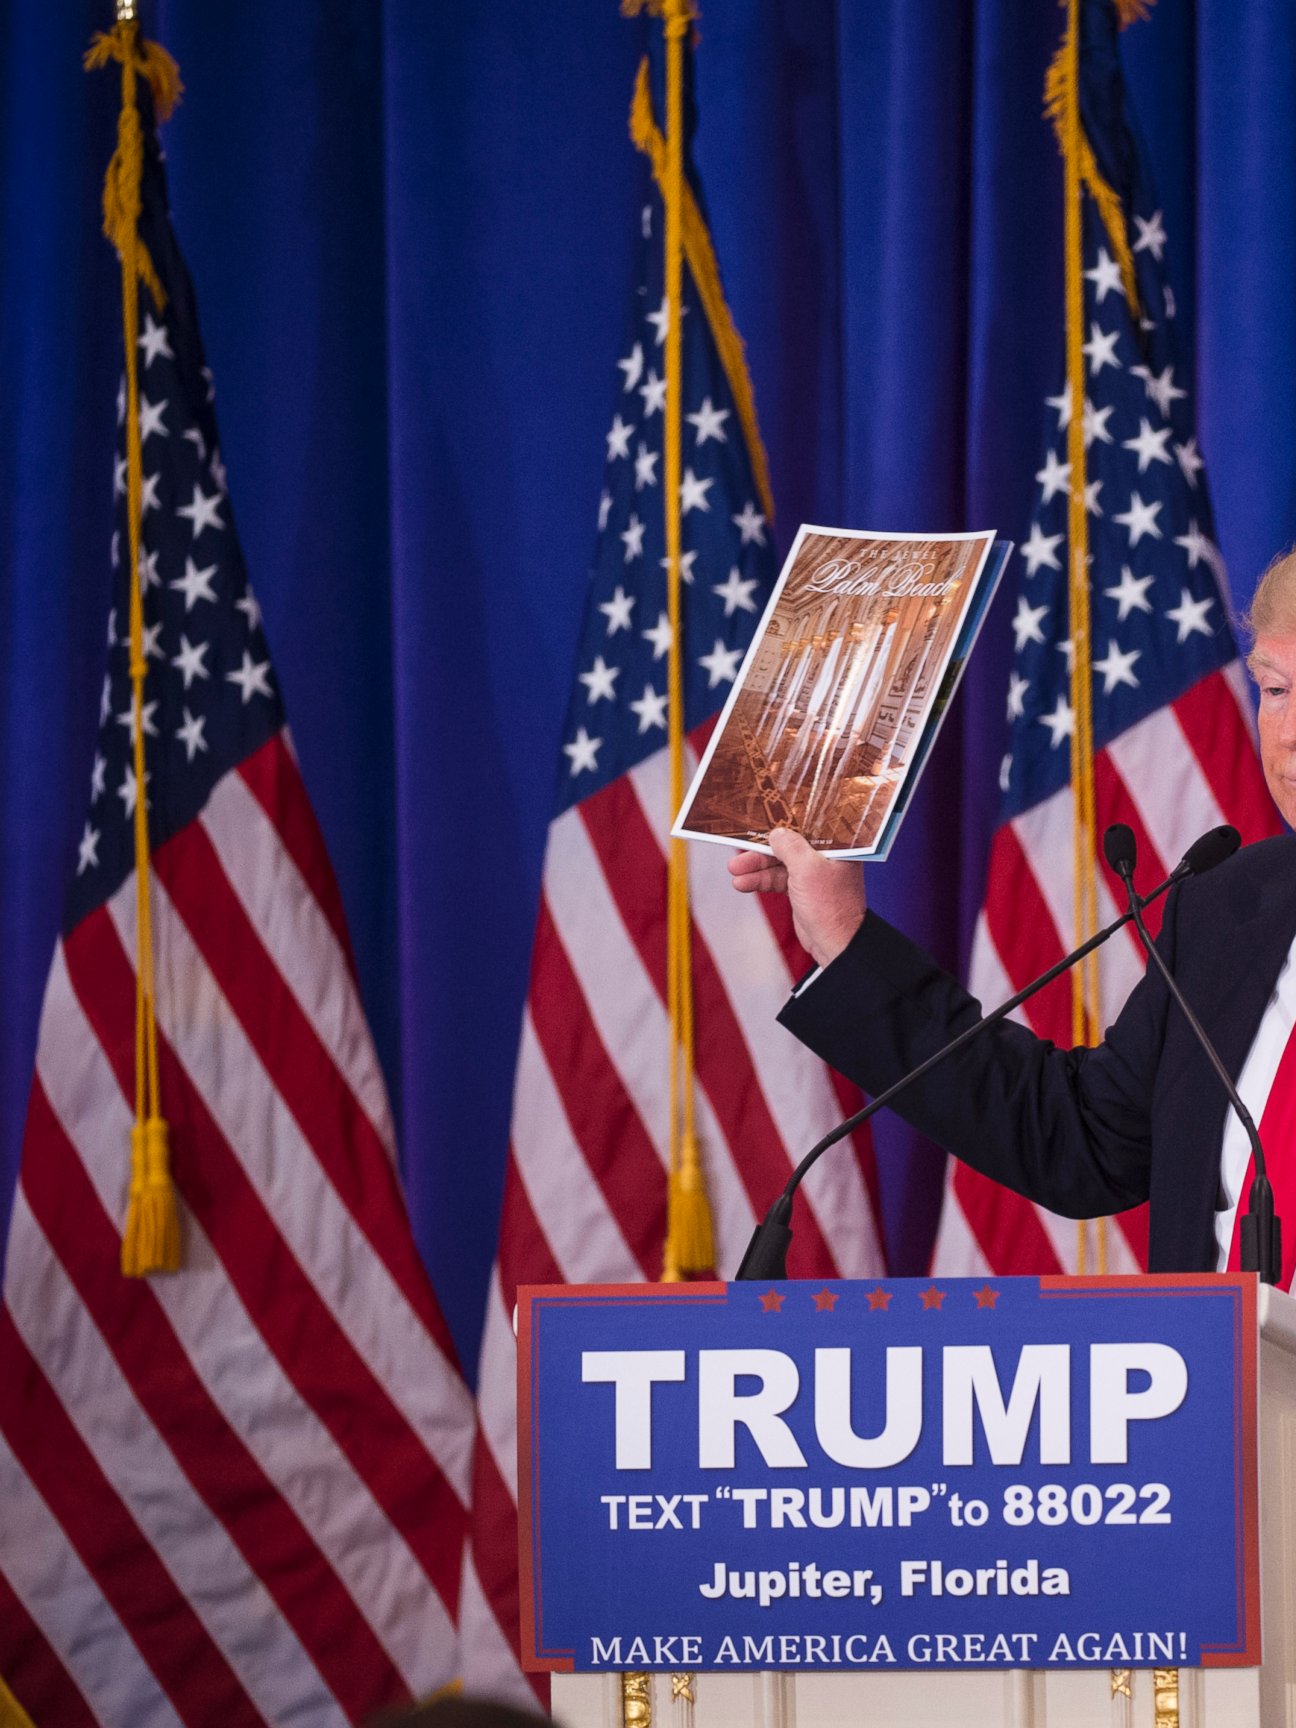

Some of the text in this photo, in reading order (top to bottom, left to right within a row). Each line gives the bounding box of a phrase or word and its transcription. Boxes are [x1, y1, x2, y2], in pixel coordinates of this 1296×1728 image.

[860, 548, 937, 561] THE JEWEL
[804, 558, 966, 597] Palm Beach
[582, 1342, 1188, 1470] TRUMP
[600, 1494, 708, 1530] TEXT
[949, 1492, 989, 1528] to
[1003, 1483, 1172, 1526] 88022
[699, 1560, 1070, 1606] Jupiter, Florida
[590, 1632, 1187, 1664] MAKE AMERICA GREAT AGAIN!
